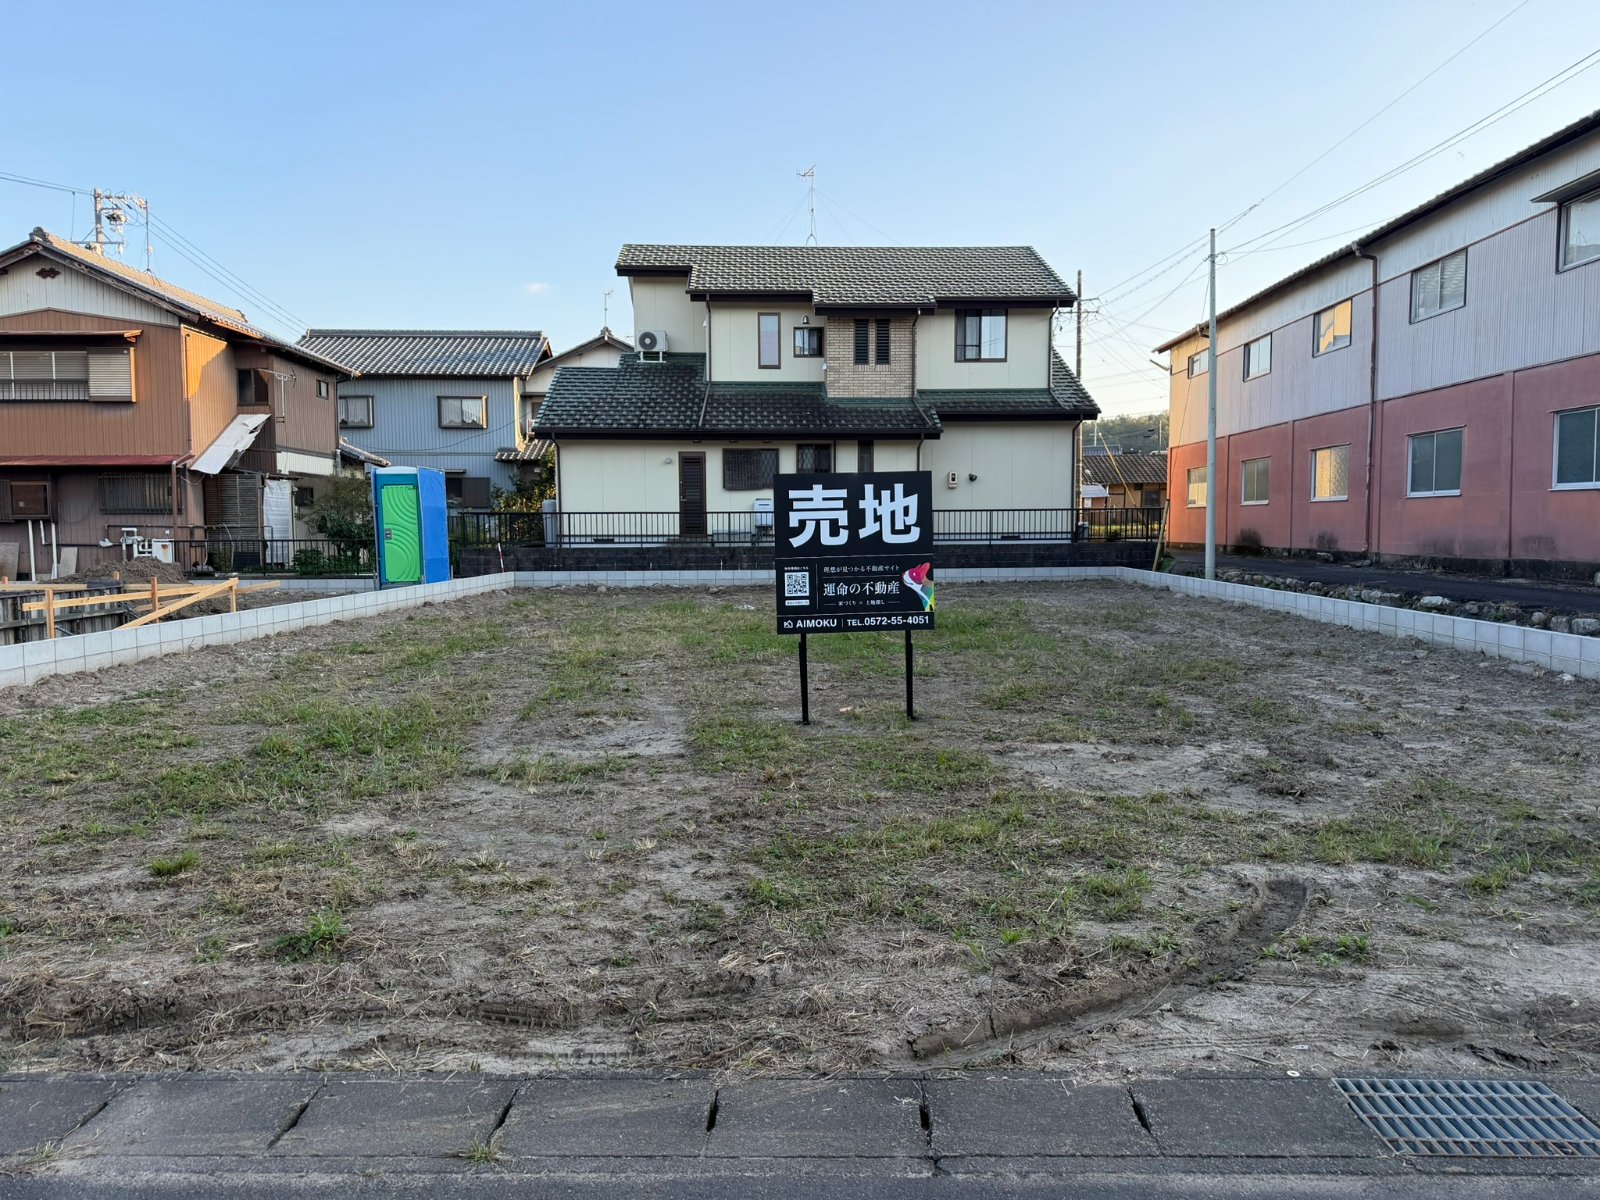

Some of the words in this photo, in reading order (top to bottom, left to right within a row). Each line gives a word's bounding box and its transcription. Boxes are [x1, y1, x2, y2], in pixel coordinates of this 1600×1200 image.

[788, 483, 921, 548] 売地
[823, 565, 900, 573] 理想が見つかる不動産サイト
[823, 581, 900, 596] 運命の不動産
[796, 618, 837, 628] AIMOKU
